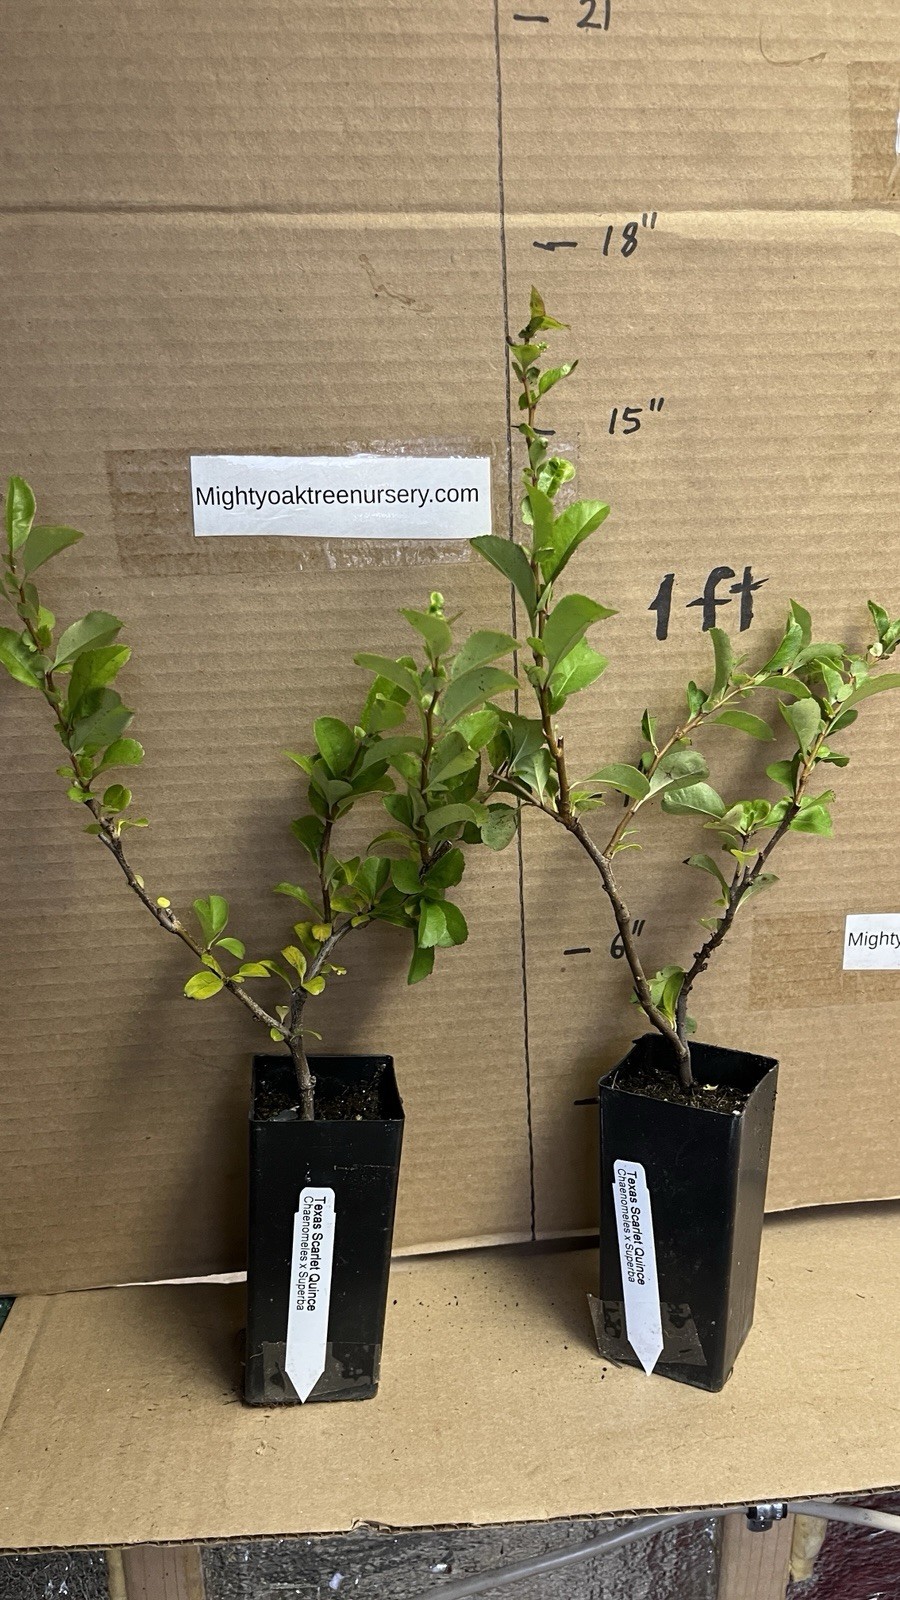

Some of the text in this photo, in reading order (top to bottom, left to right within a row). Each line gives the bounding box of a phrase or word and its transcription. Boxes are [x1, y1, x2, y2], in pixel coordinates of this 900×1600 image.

[196, 486, 479, 510] Mightyoaktreenursery.com
[648, 566, 769, 641] 1 ft
[848, 931, 900, 950] Mighty
[300, 1195, 314, 1262] Chaenomeles
[307, 1196, 326, 1311] Texas Scarlet Quince
[617, 1168, 631, 1234] Chaenomeles
[625, 1242, 636, 1283] Superba
[627, 1171, 645, 1286] Texas Scarlet Quince
[296, 1271, 309, 1311] Superba
